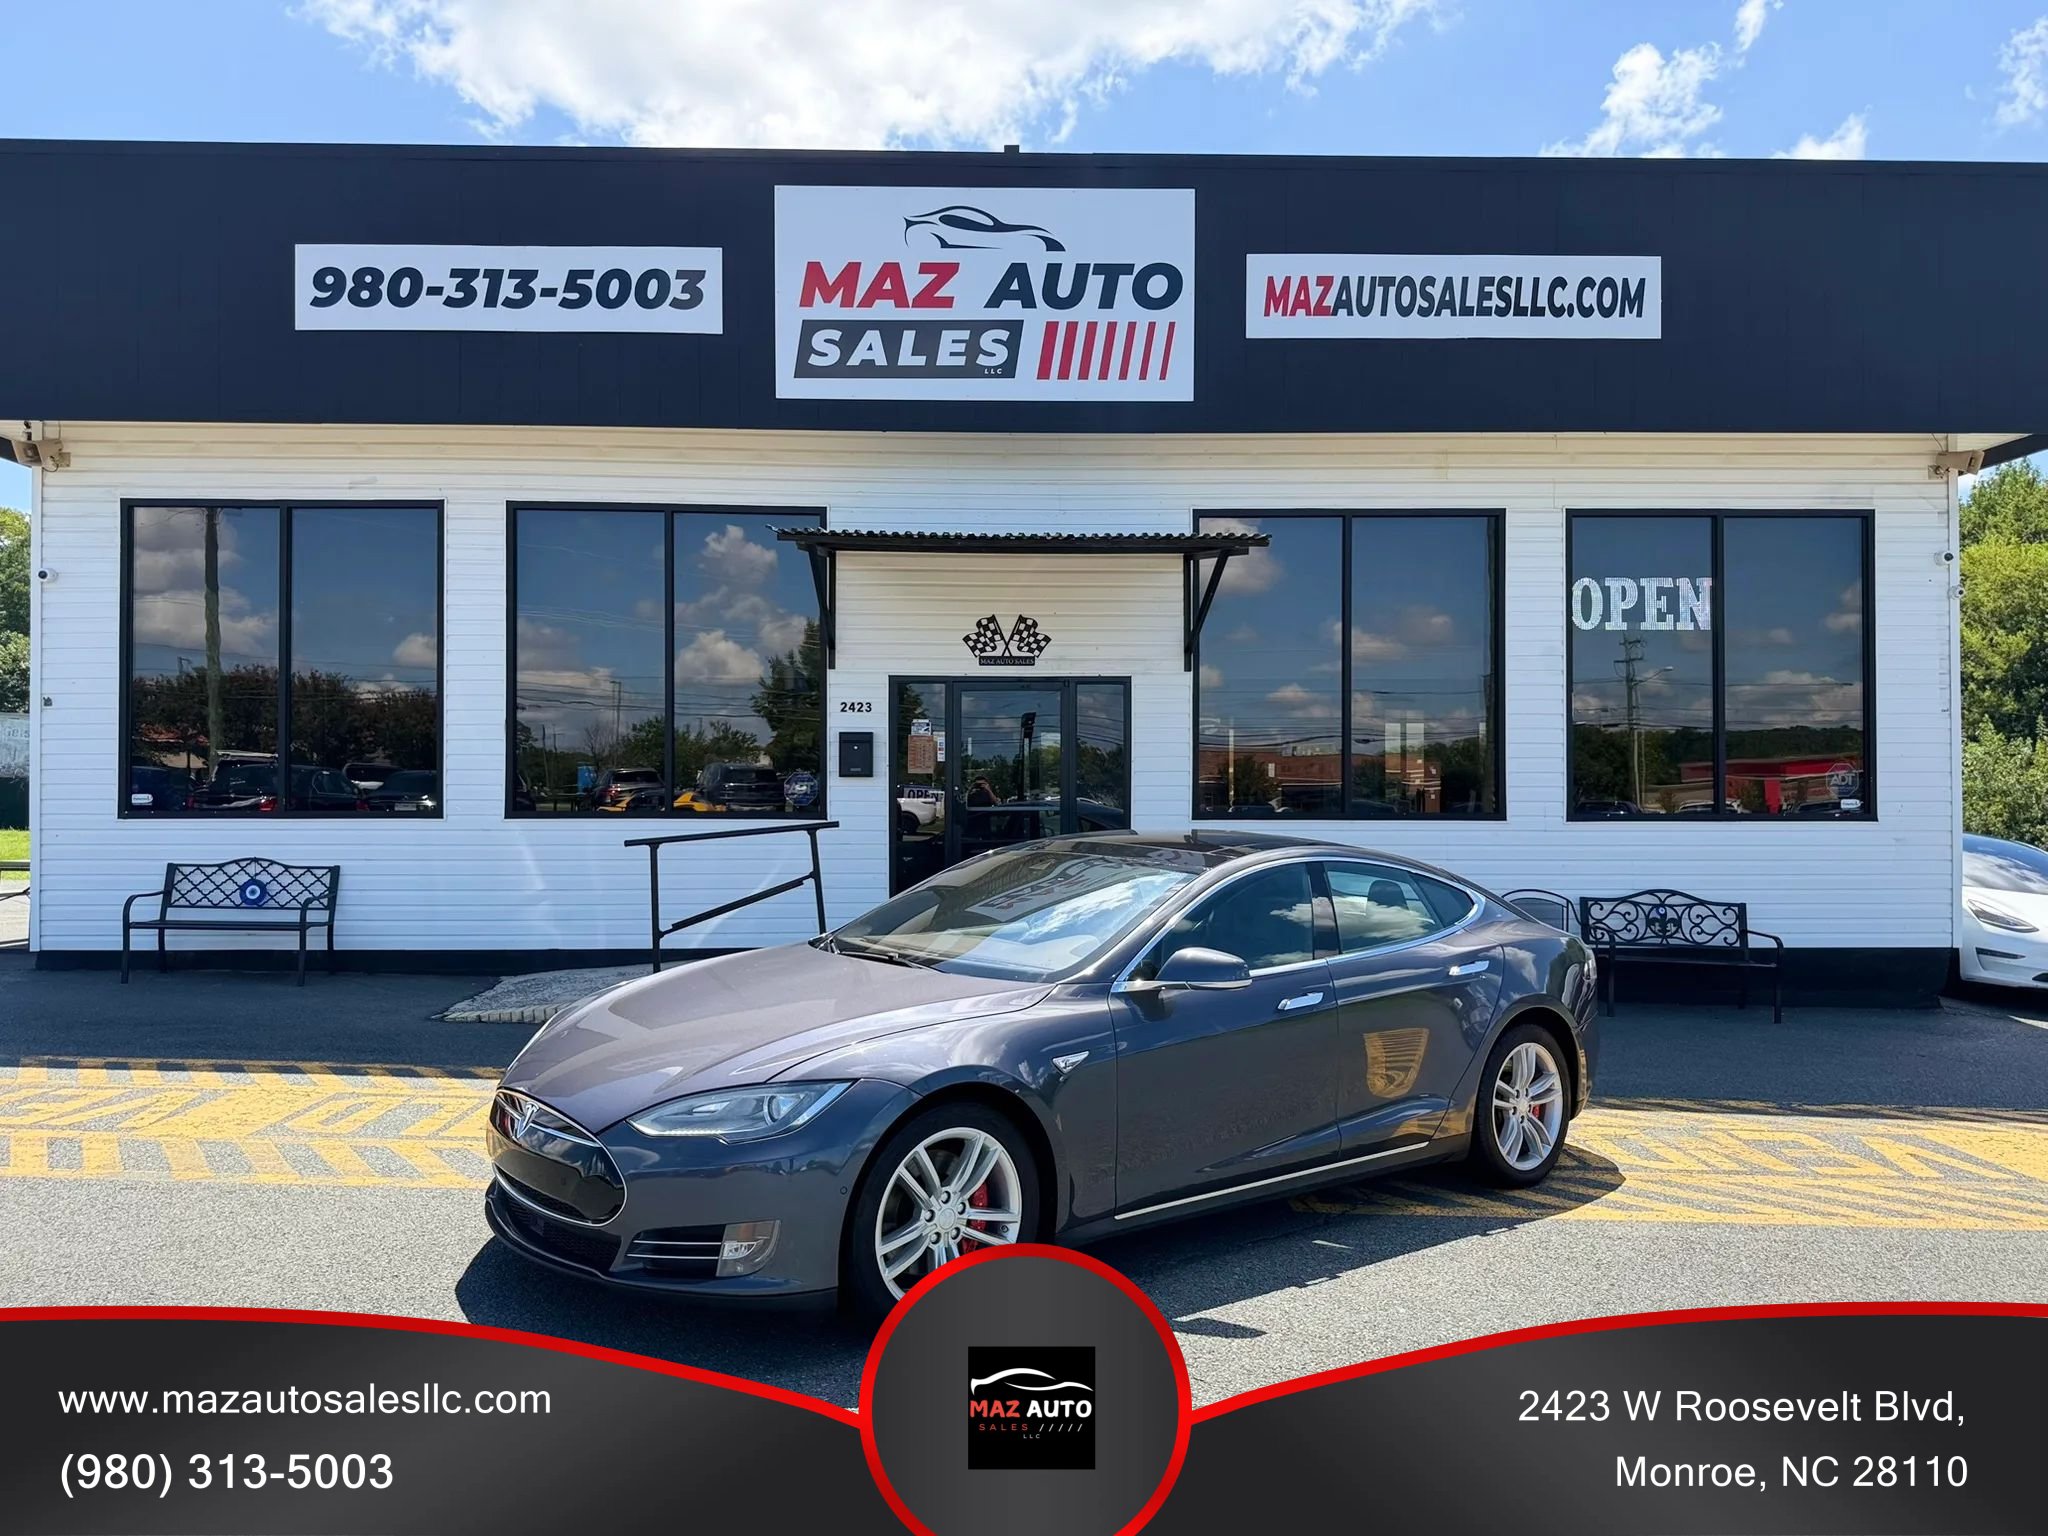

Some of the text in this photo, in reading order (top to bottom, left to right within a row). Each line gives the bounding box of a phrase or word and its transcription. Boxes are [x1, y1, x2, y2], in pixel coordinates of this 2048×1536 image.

[310, 266, 707, 311] 980-313-5003
[799, 261, 1184, 311] MAZ AUTO
[1263, 275, 1647, 319] MAZAUTOSALESLLC.COM
[807, 328, 1010, 367] SALES
[1571, 576, 1713, 631] OPEN
[840, 701, 872, 713] 2423
[1830, 773, 1855, 785] ADT
